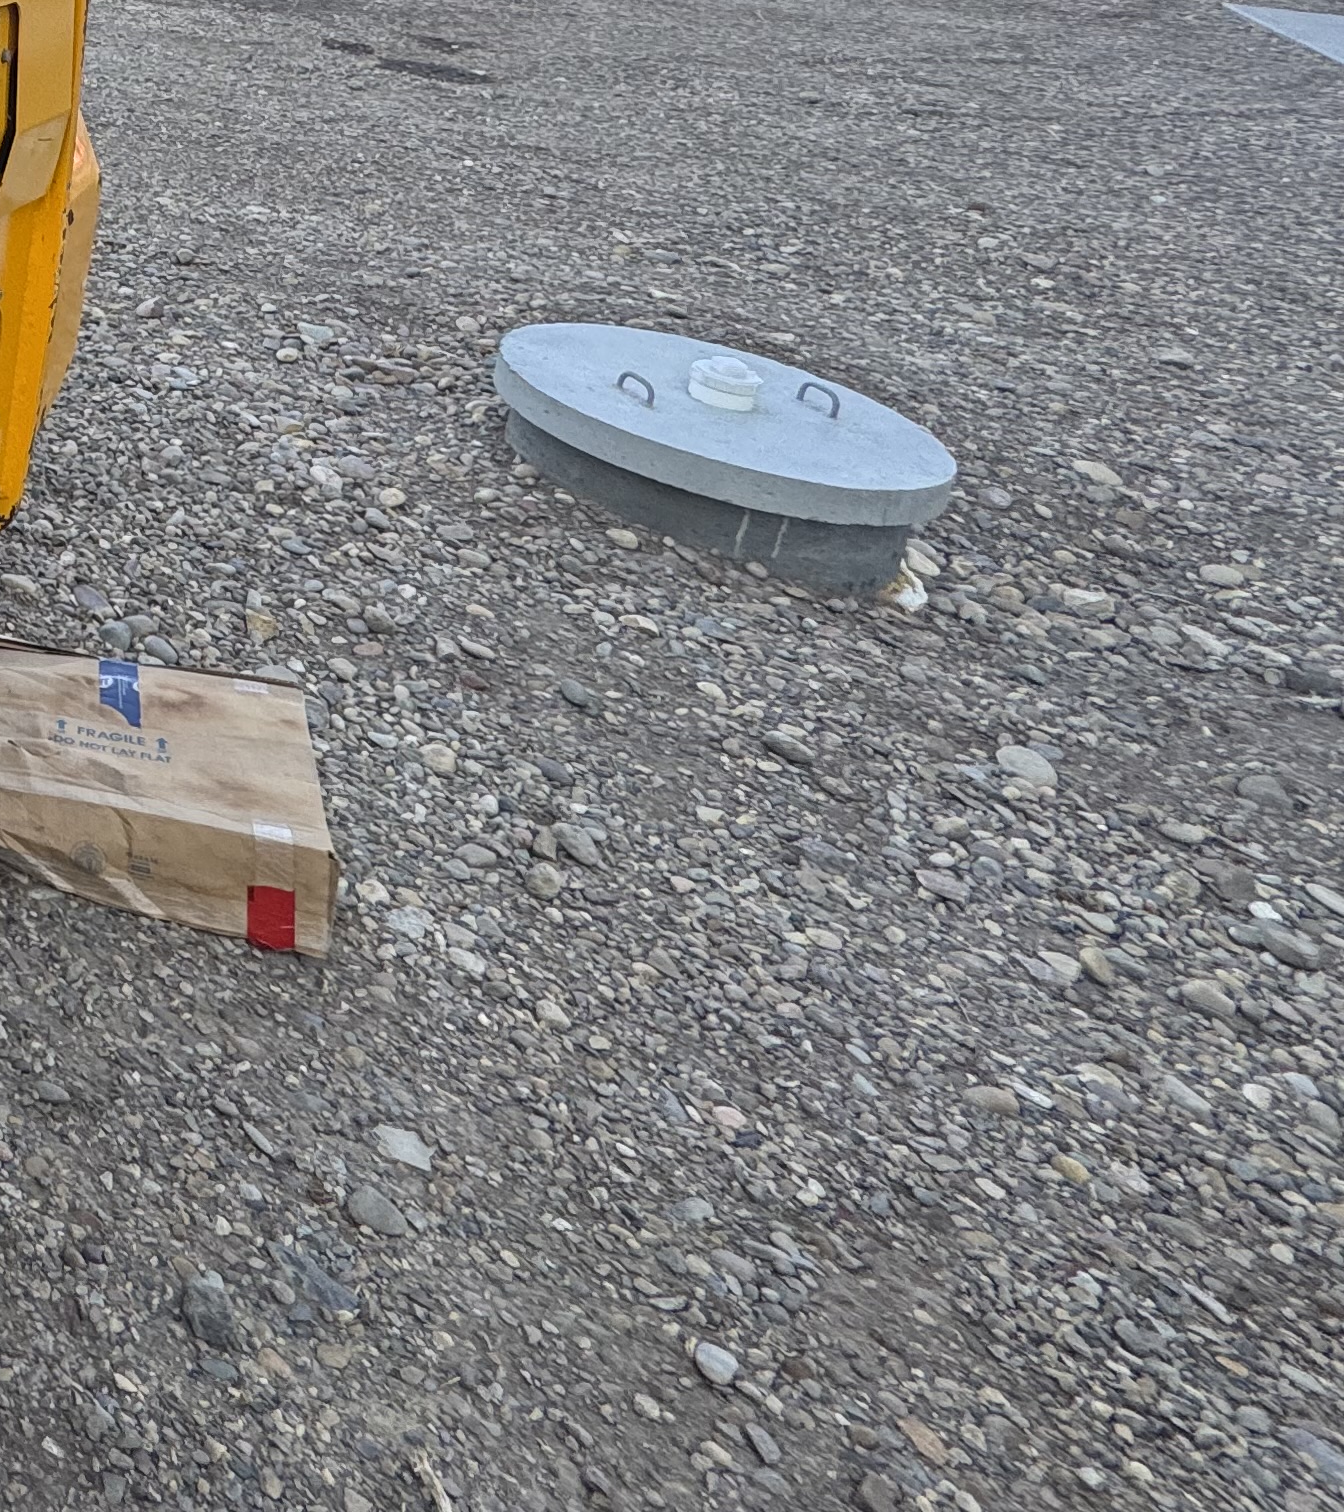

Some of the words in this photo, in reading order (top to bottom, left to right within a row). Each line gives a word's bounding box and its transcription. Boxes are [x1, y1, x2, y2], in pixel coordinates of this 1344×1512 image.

[53, 734, 76, 746] DO
[78, 740, 109, 753] NOT
[111, 746, 138, 758] LAY
[139, 751, 172, 764] FLAT
[76, 726, 147, 747] FRAGILE
